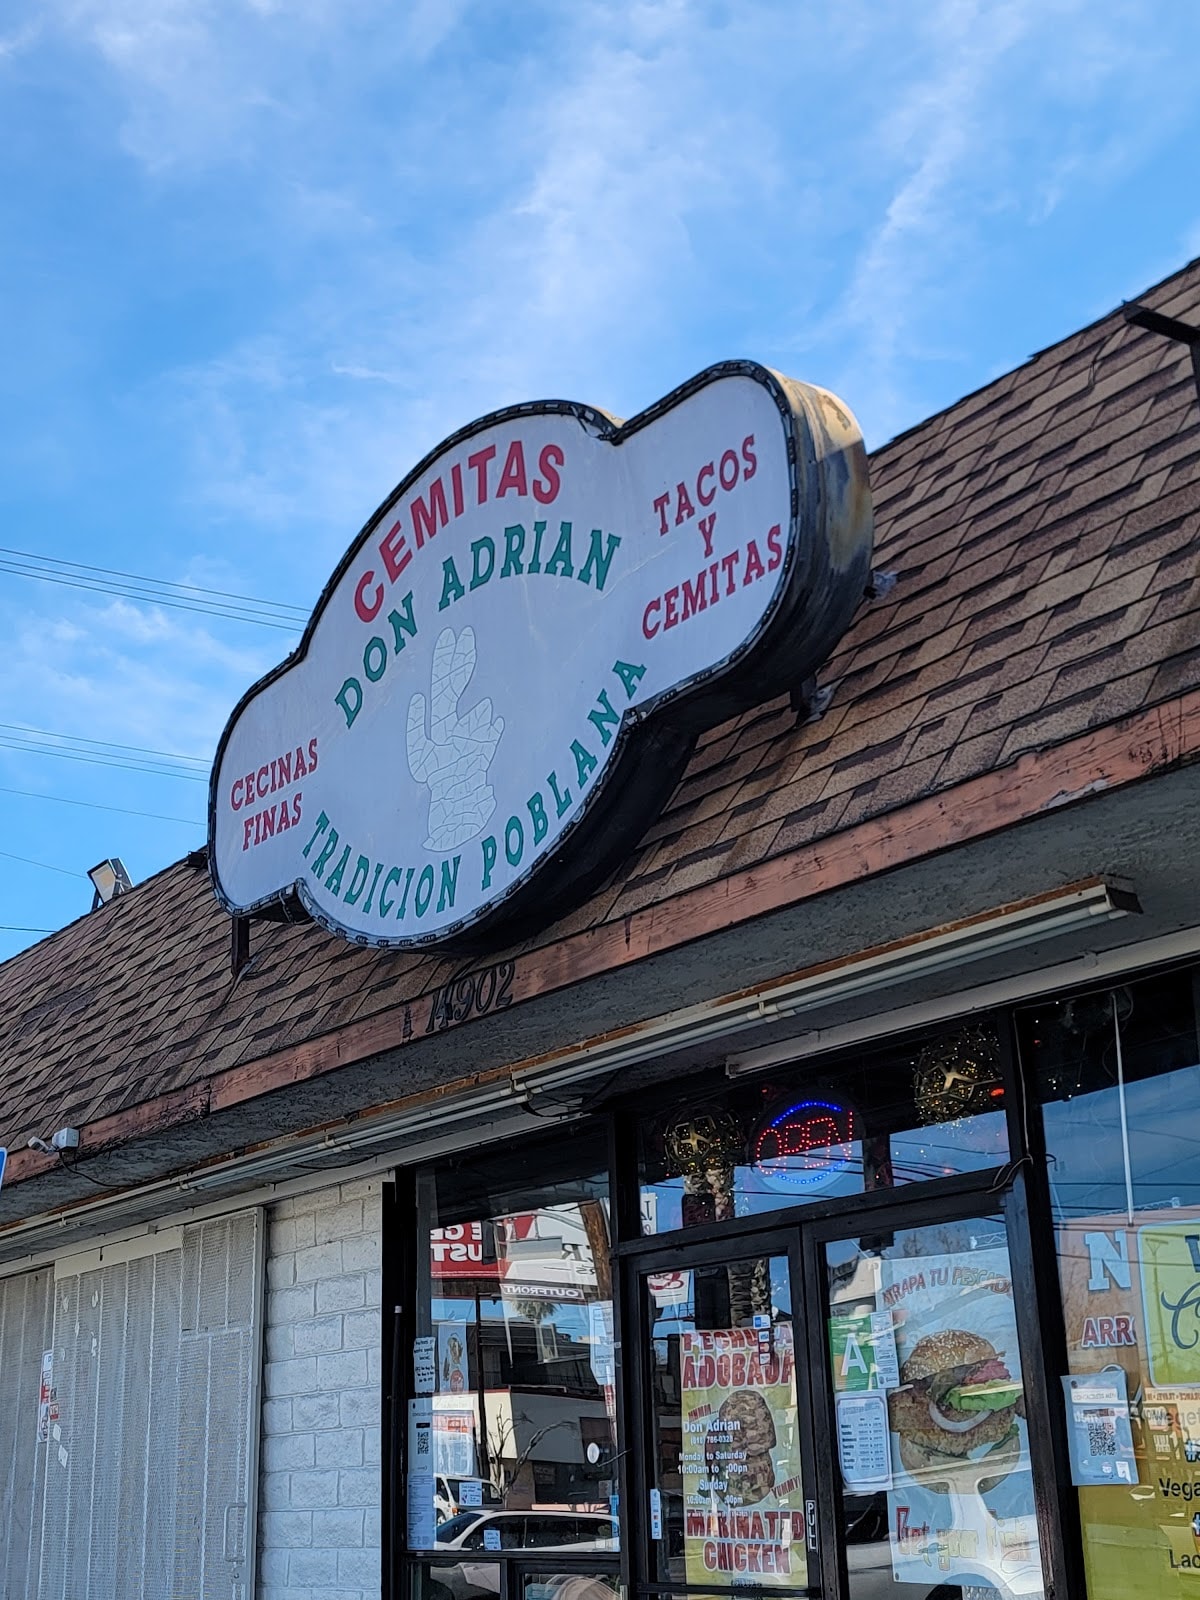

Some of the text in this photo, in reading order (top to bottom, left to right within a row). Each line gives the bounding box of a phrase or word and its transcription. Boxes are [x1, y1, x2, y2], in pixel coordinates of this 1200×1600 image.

[653, 434, 757, 536] TACOS
[354, 440, 564, 623] CEMITAS
[698, 512, 717, 558] Y
[642, 523, 783, 640] CEMITAS
[335, 520, 622, 729] DON ADRIAN
[230, 737, 318, 811] CECINAS
[303, 660, 647, 921] TRADICION POBLANA
[242, 792, 302, 851] FINAS
[756, 1109, 853, 1176] OPEN
[929, 1267, 949, 1287] TU
[682, 1324, 793, 1352] PECHUA
[841, 1332, 869, 1376] A
[1082, 1316, 1138, 1347] ARR
[682, 1349, 794, 1389] ADOBADA
[684, 1418, 741, 1433] Don Adrian
[677, 1464, 709, 1475] 10:00am
[711, 1465, 719, 1474] to
[678, 1450, 747, 1463] Monday to Saturday
[1159, 1478, 1200, 1501] Vega
[808, 1502, 817, 1550] PULL
[704, 1541, 791, 1573] CHICKEN
